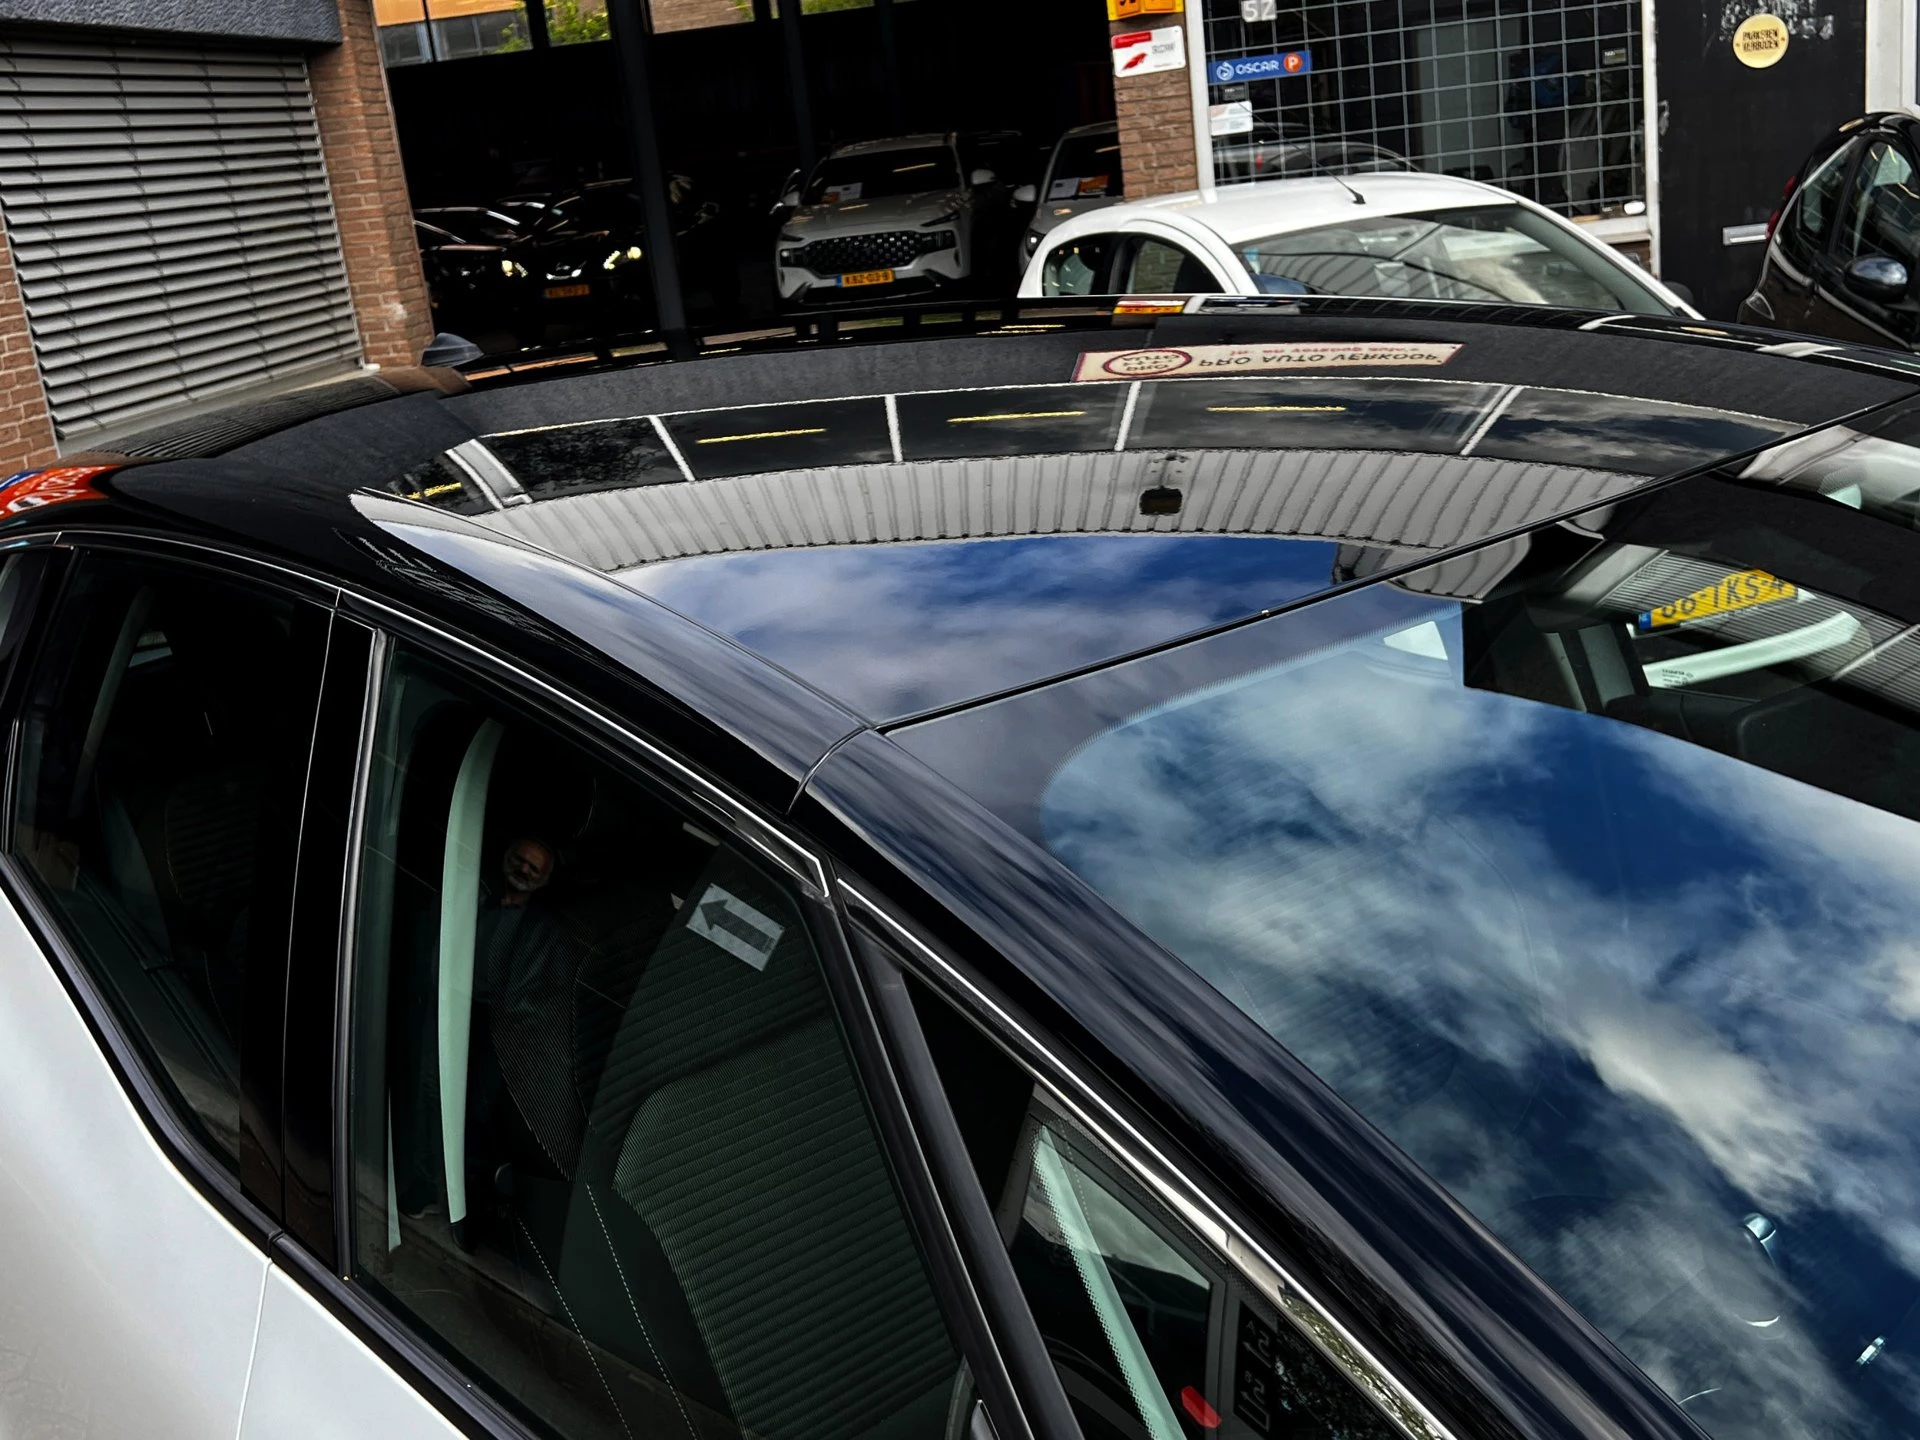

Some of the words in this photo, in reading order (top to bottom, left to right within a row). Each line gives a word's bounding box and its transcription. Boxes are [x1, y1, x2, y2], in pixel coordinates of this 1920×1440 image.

[1243, 0, 1277, 21] 52
[1235, 60, 1279, 75] OSCAR
[1287, 56, 1299, 71] P
